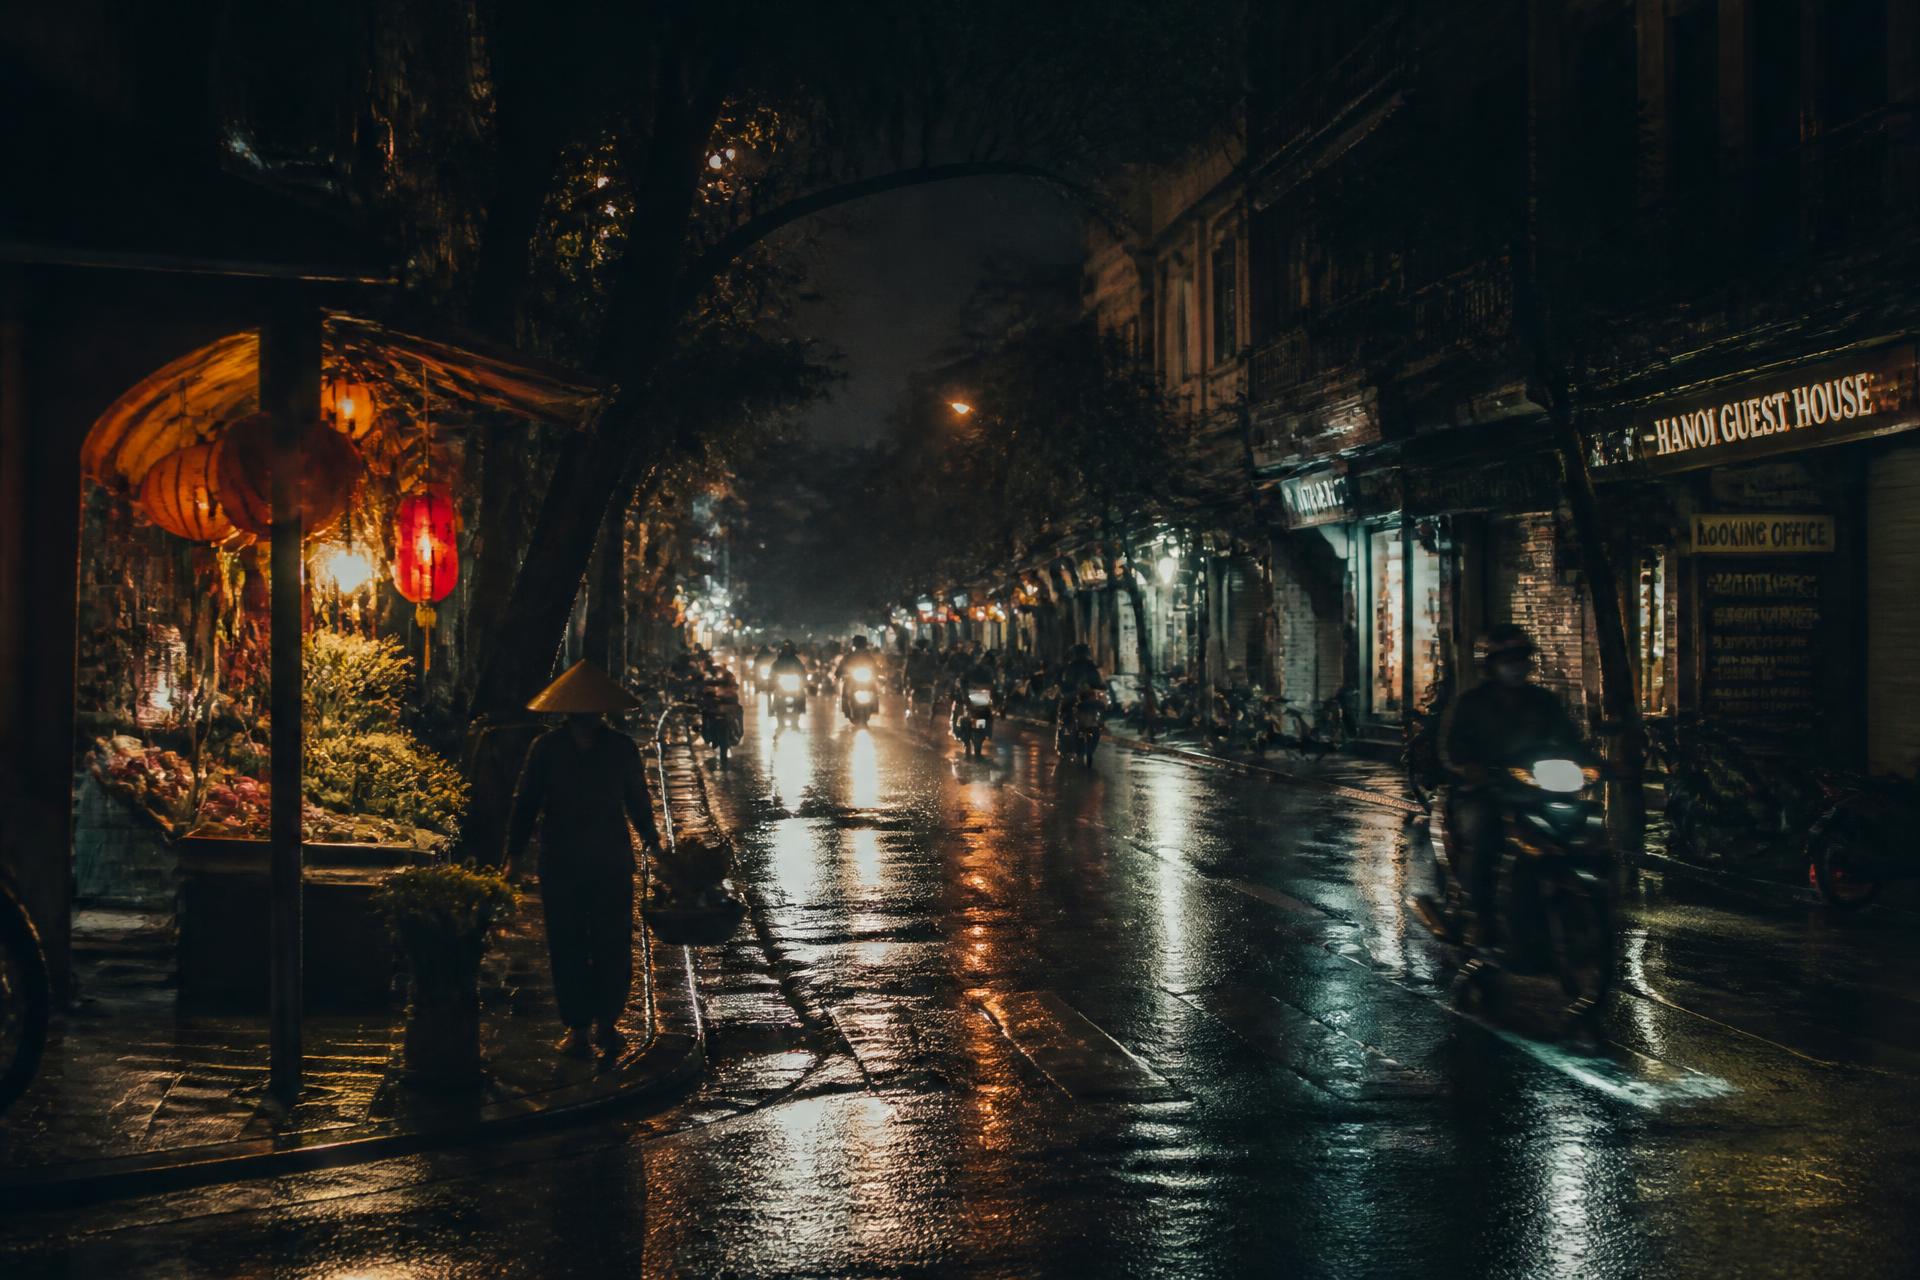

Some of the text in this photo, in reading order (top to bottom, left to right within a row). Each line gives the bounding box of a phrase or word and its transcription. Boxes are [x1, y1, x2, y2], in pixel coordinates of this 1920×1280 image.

[1719, 390, 1791, 443] GUEST
[1791, 372, 1874, 429] HOUSE
[1771, 521, 1827, 547] OFFICE
